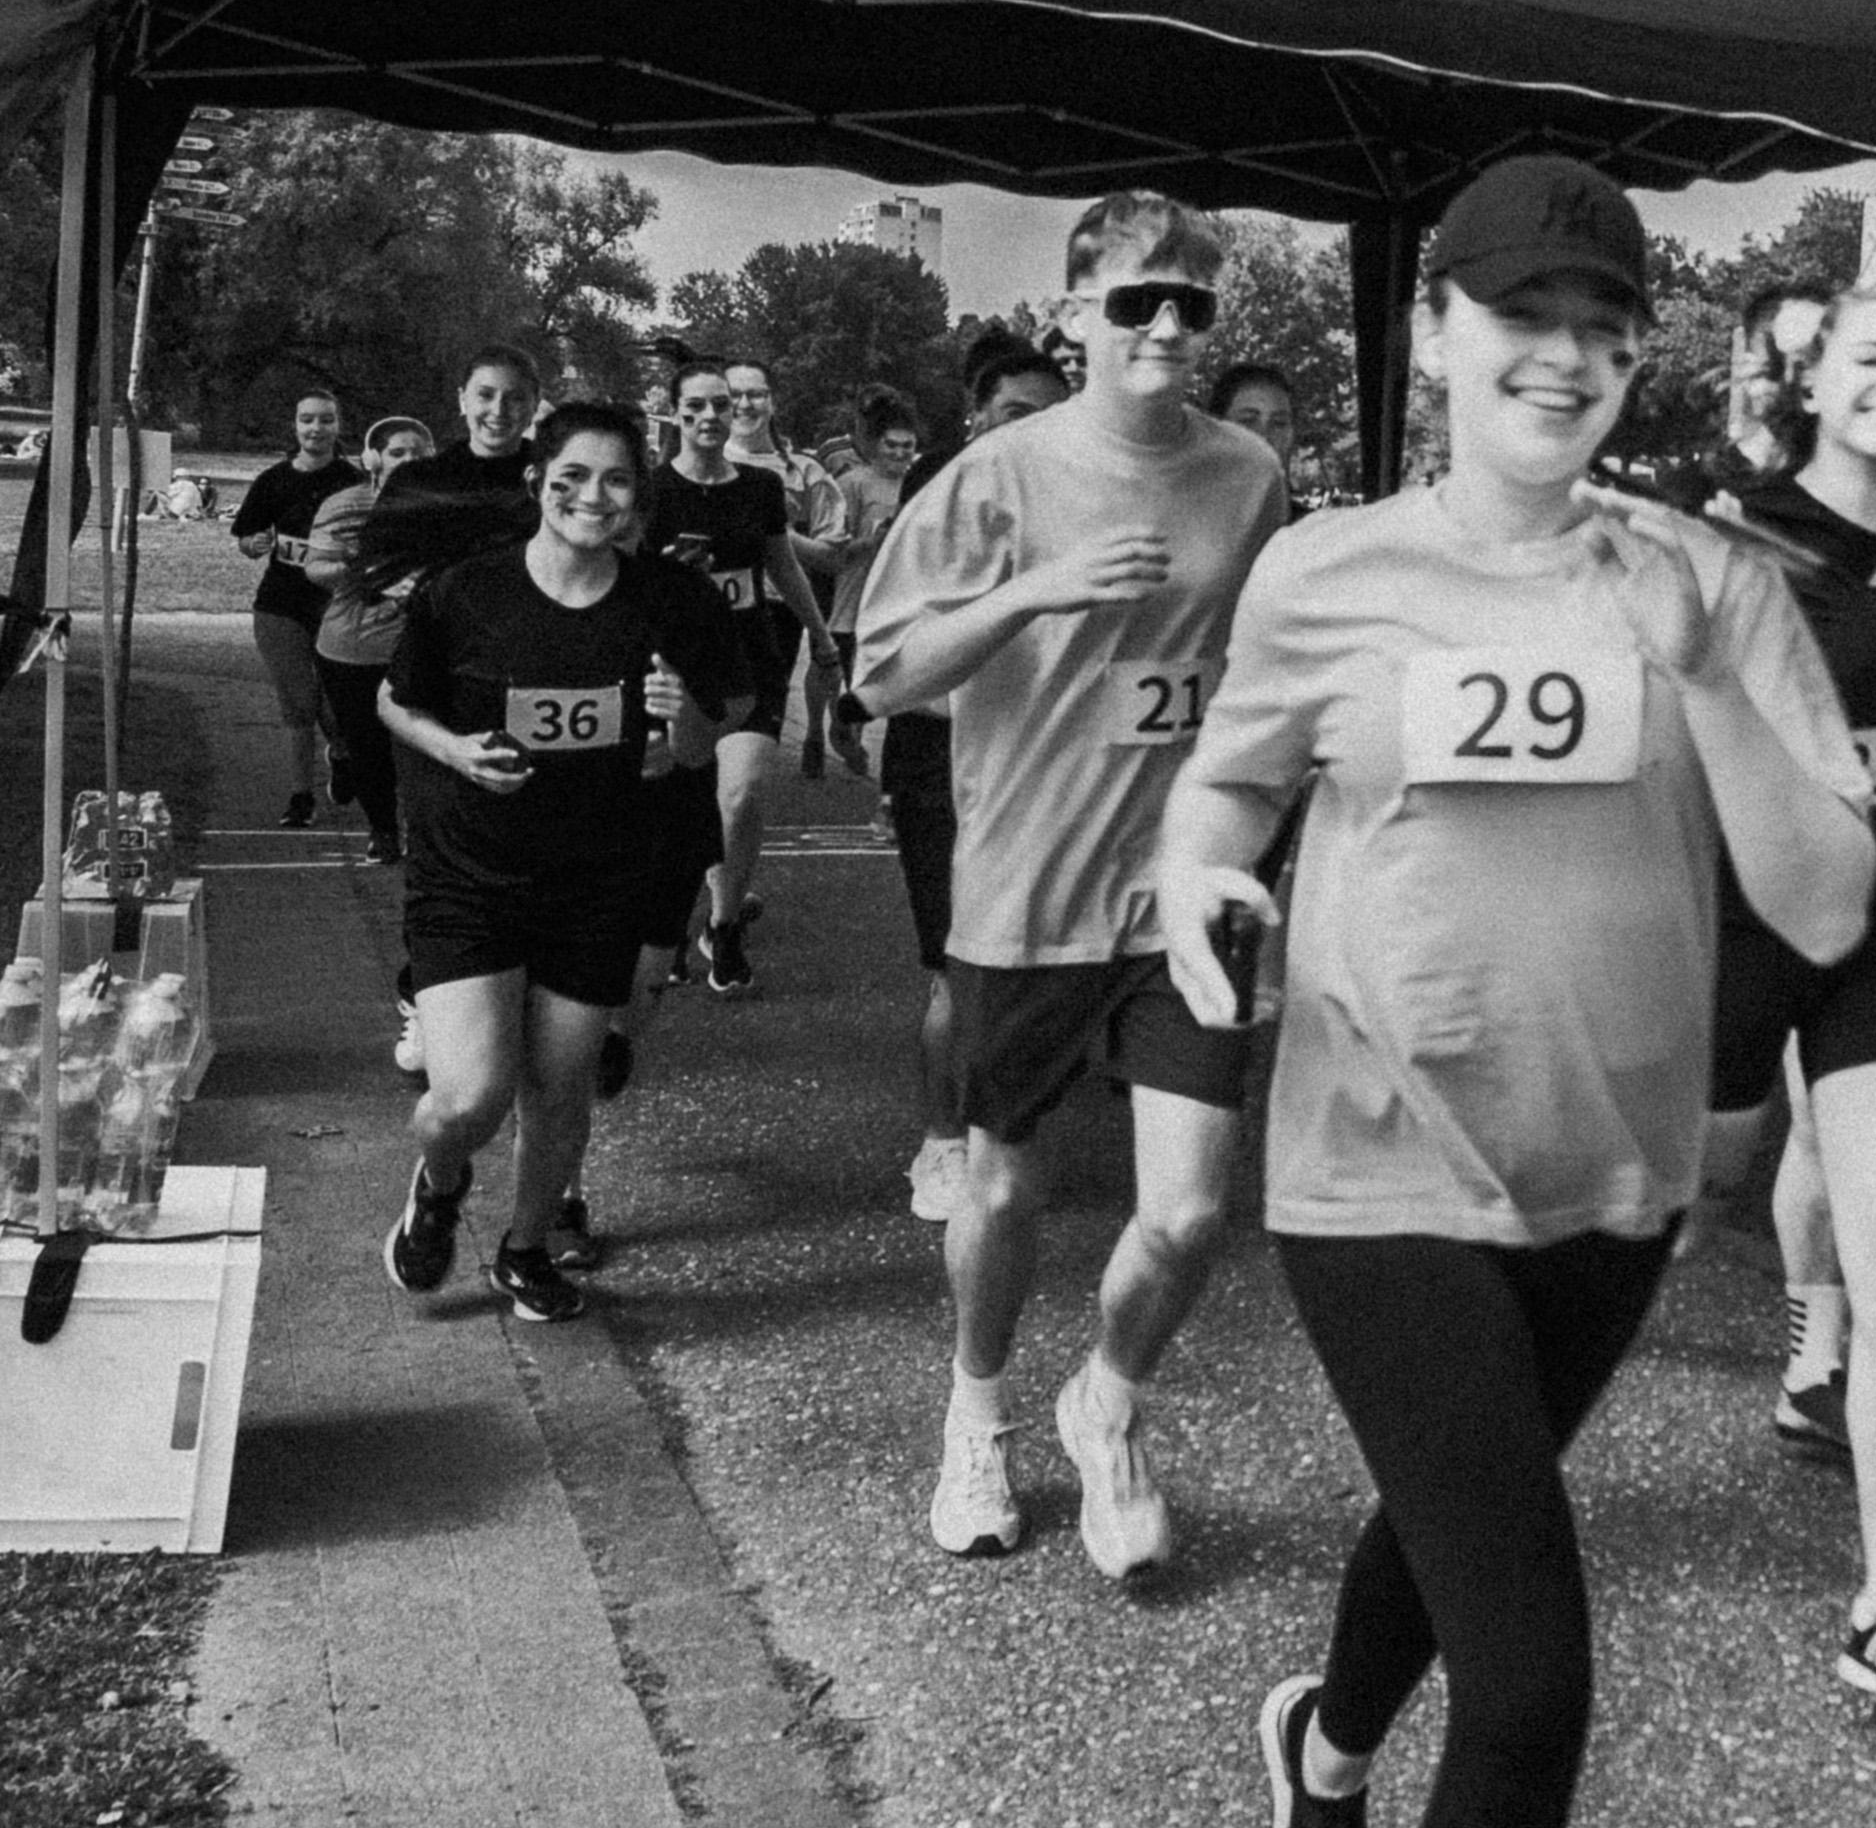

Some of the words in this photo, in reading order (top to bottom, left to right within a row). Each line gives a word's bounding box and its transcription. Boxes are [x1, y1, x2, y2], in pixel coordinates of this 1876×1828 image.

[285, 541, 309, 562] 17
[723, 578, 740, 604] 0
[531, 699, 599, 742] 36
[1136, 674, 1203, 731] 21
[1455, 671, 1586, 760] 29
